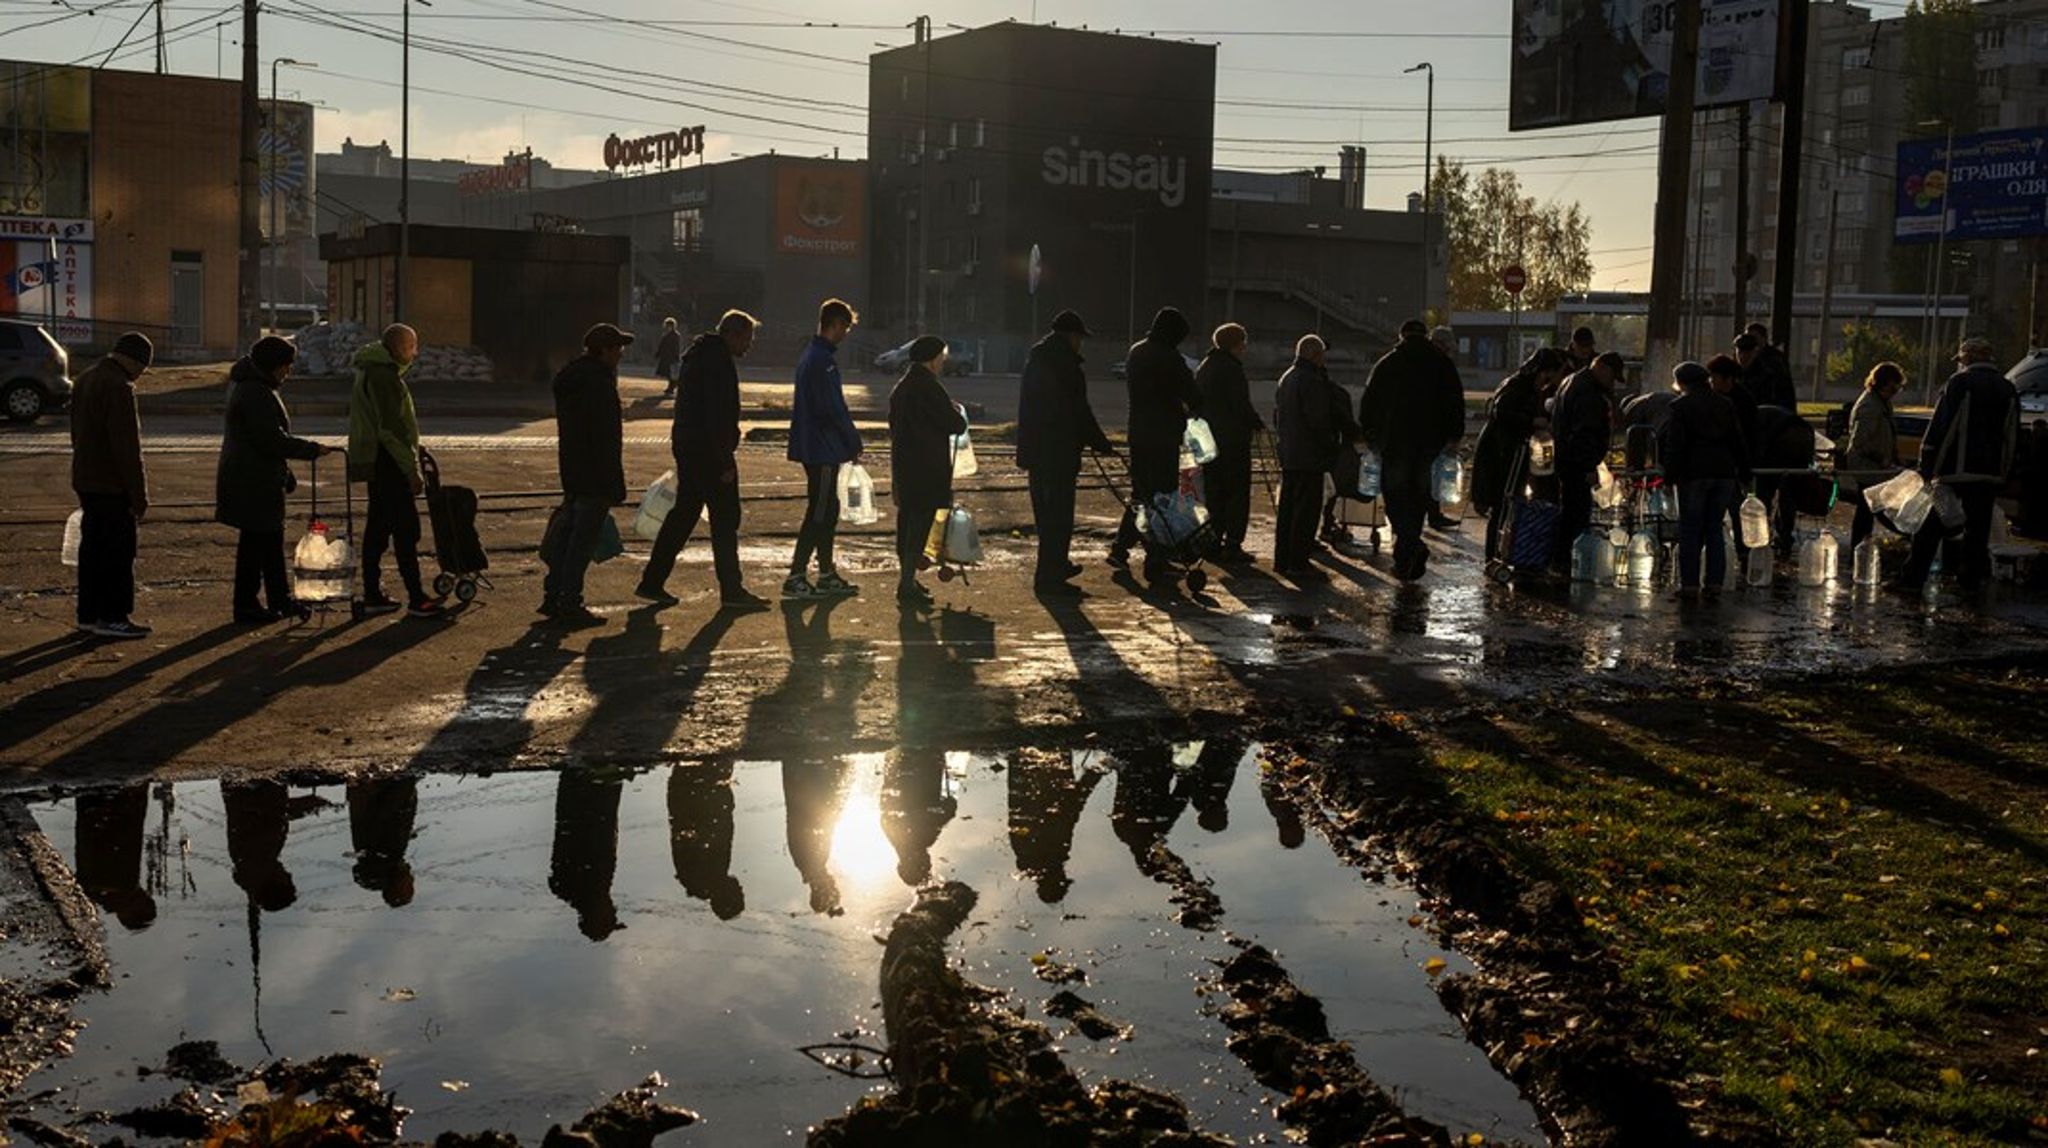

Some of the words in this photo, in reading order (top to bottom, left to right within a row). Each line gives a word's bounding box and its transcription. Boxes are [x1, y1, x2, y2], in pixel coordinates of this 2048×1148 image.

[603, 124, 706, 169] Фокстрот
[1041, 135, 1187, 208] sinsay
[783, 234, 857, 254] Фокстрот
[64, 244, 77, 320] АПТЕКА
